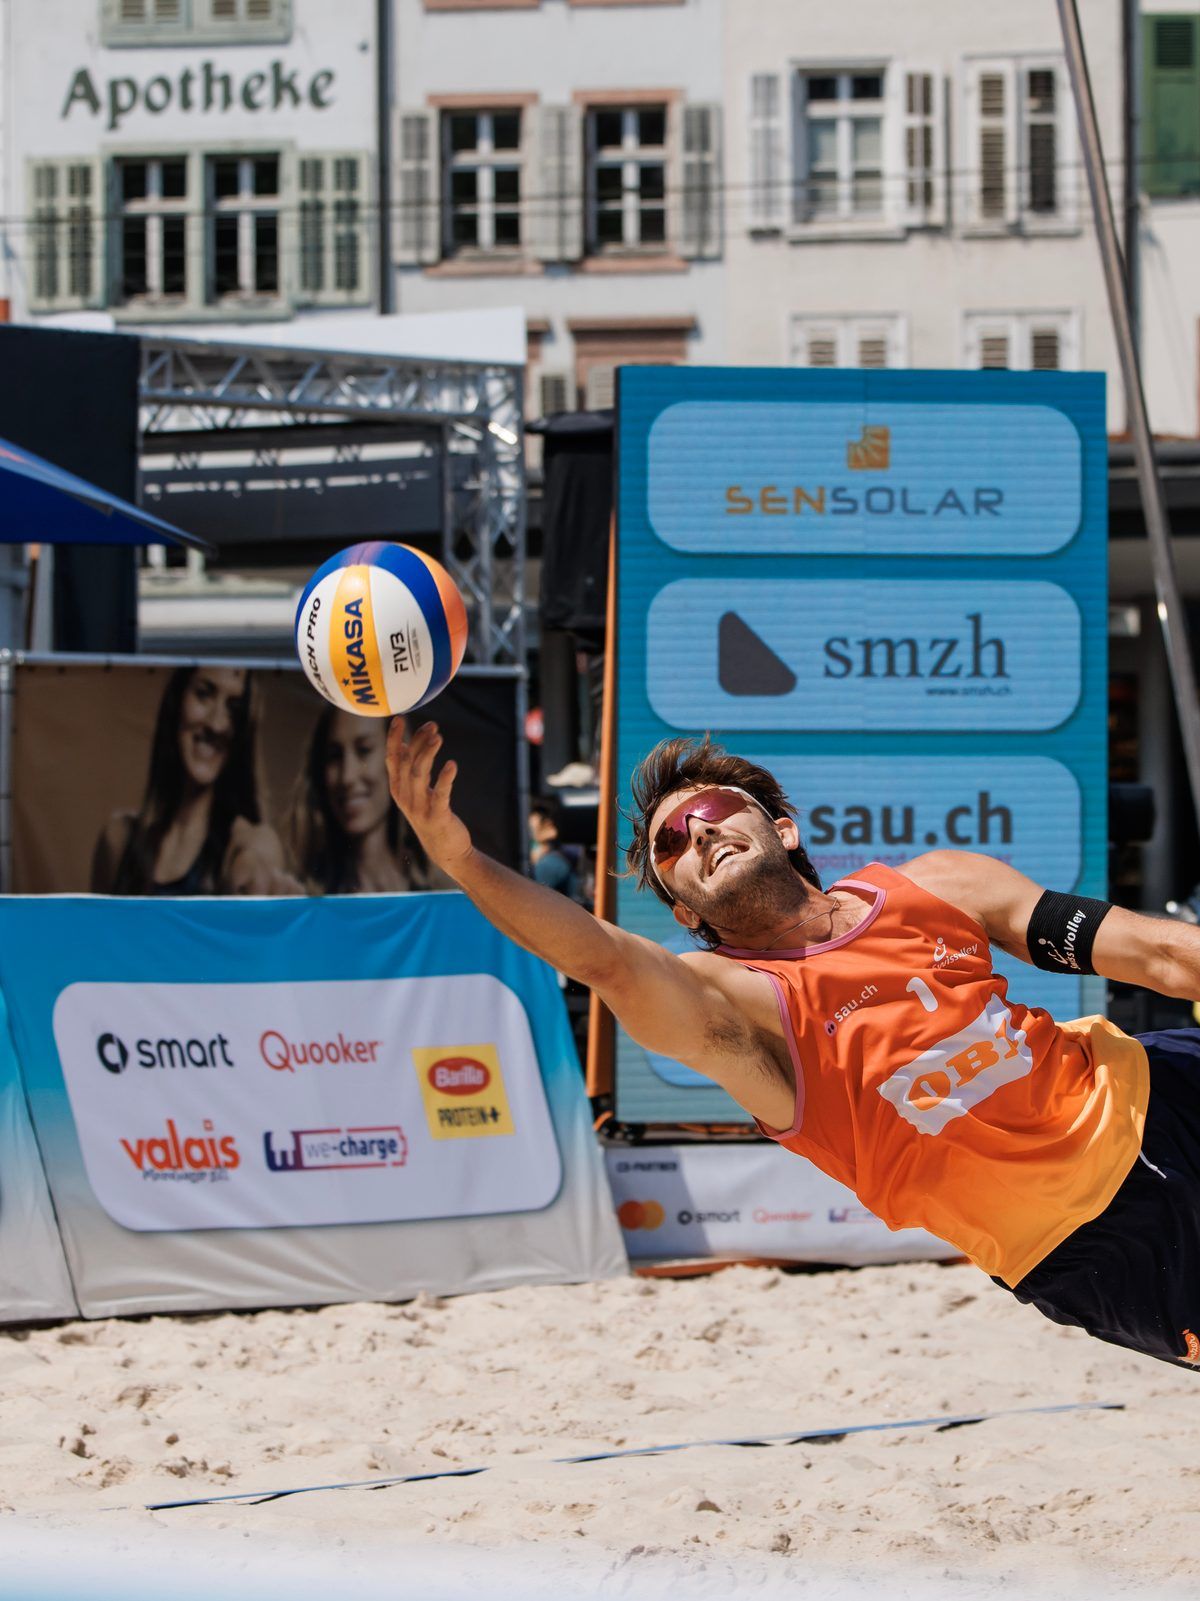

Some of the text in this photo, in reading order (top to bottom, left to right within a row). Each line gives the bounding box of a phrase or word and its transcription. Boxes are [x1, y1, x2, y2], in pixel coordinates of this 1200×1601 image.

[61, 60, 335, 131] Apotheke
[725, 485, 1004, 517] SENSOLAR
[306, 597, 321, 641] PRO
[822, 612, 1011, 679] smzh
[809, 791, 1014, 845] sau.ch
[1063, 909, 1087, 951] Volley
[834, 983, 879, 1023] sau.ch
[905, 976, 939, 1013] 1
[136, 1030, 380, 1073] smart Quooker
[908, 1017, 1019, 1112] OBI
[434, 1065, 485, 1089] Barilla
[119, 1118, 241, 1172] valais
[304, 1133, 399, 1159] we-charge
[695, 1208, 741, 1224] smart
